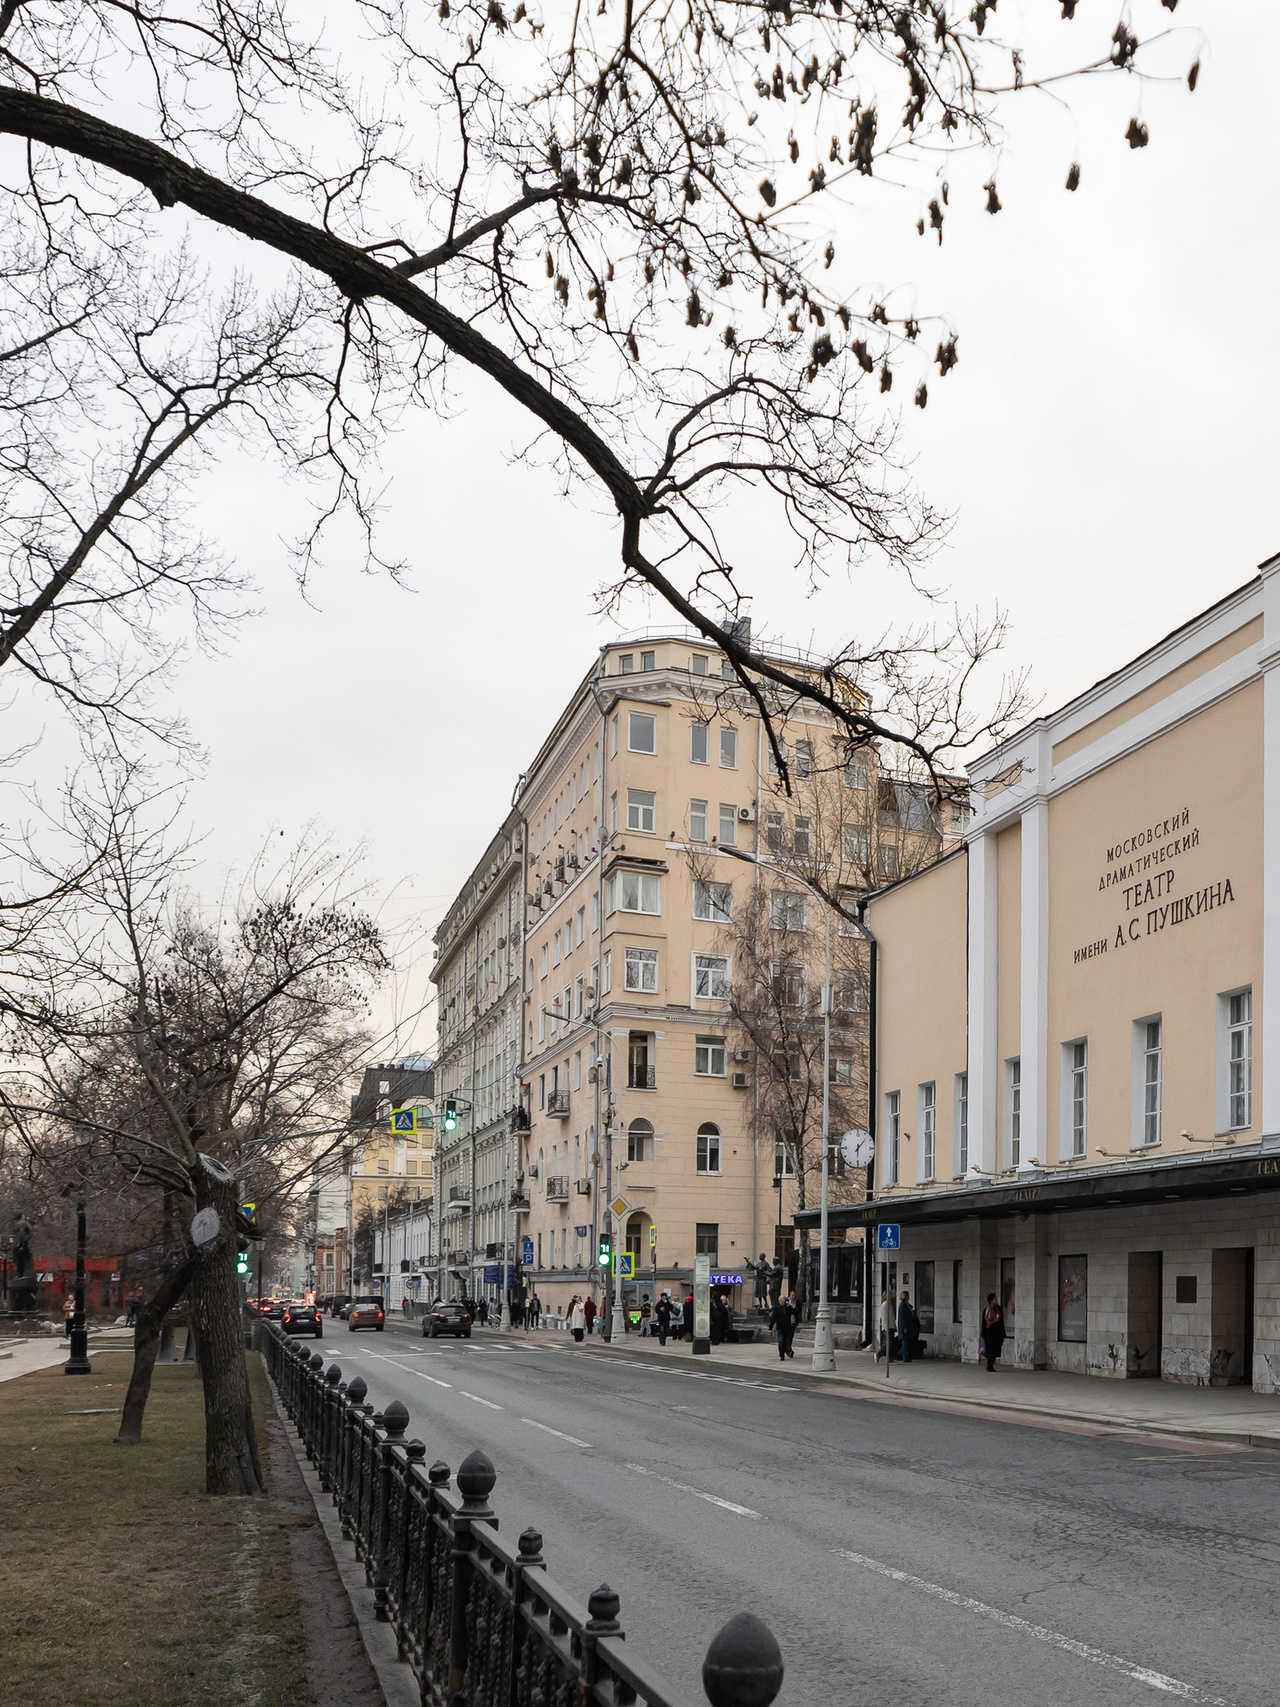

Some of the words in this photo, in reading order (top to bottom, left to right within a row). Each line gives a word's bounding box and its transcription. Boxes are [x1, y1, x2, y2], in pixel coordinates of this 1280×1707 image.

[1099, 828, 1200, 891] ДРАМАТИЧЕСКИЙ
[1107, 807, 1190, 863] МОСКОВСКИЙ
[1122, 869, 1175, 911] ТЕАТР
[1073, 938, 1108, 964] ИМЕНИ
[1146, 878, 1235, 935] ПУШКИНА
[525, 1254, 532, 1263] P
